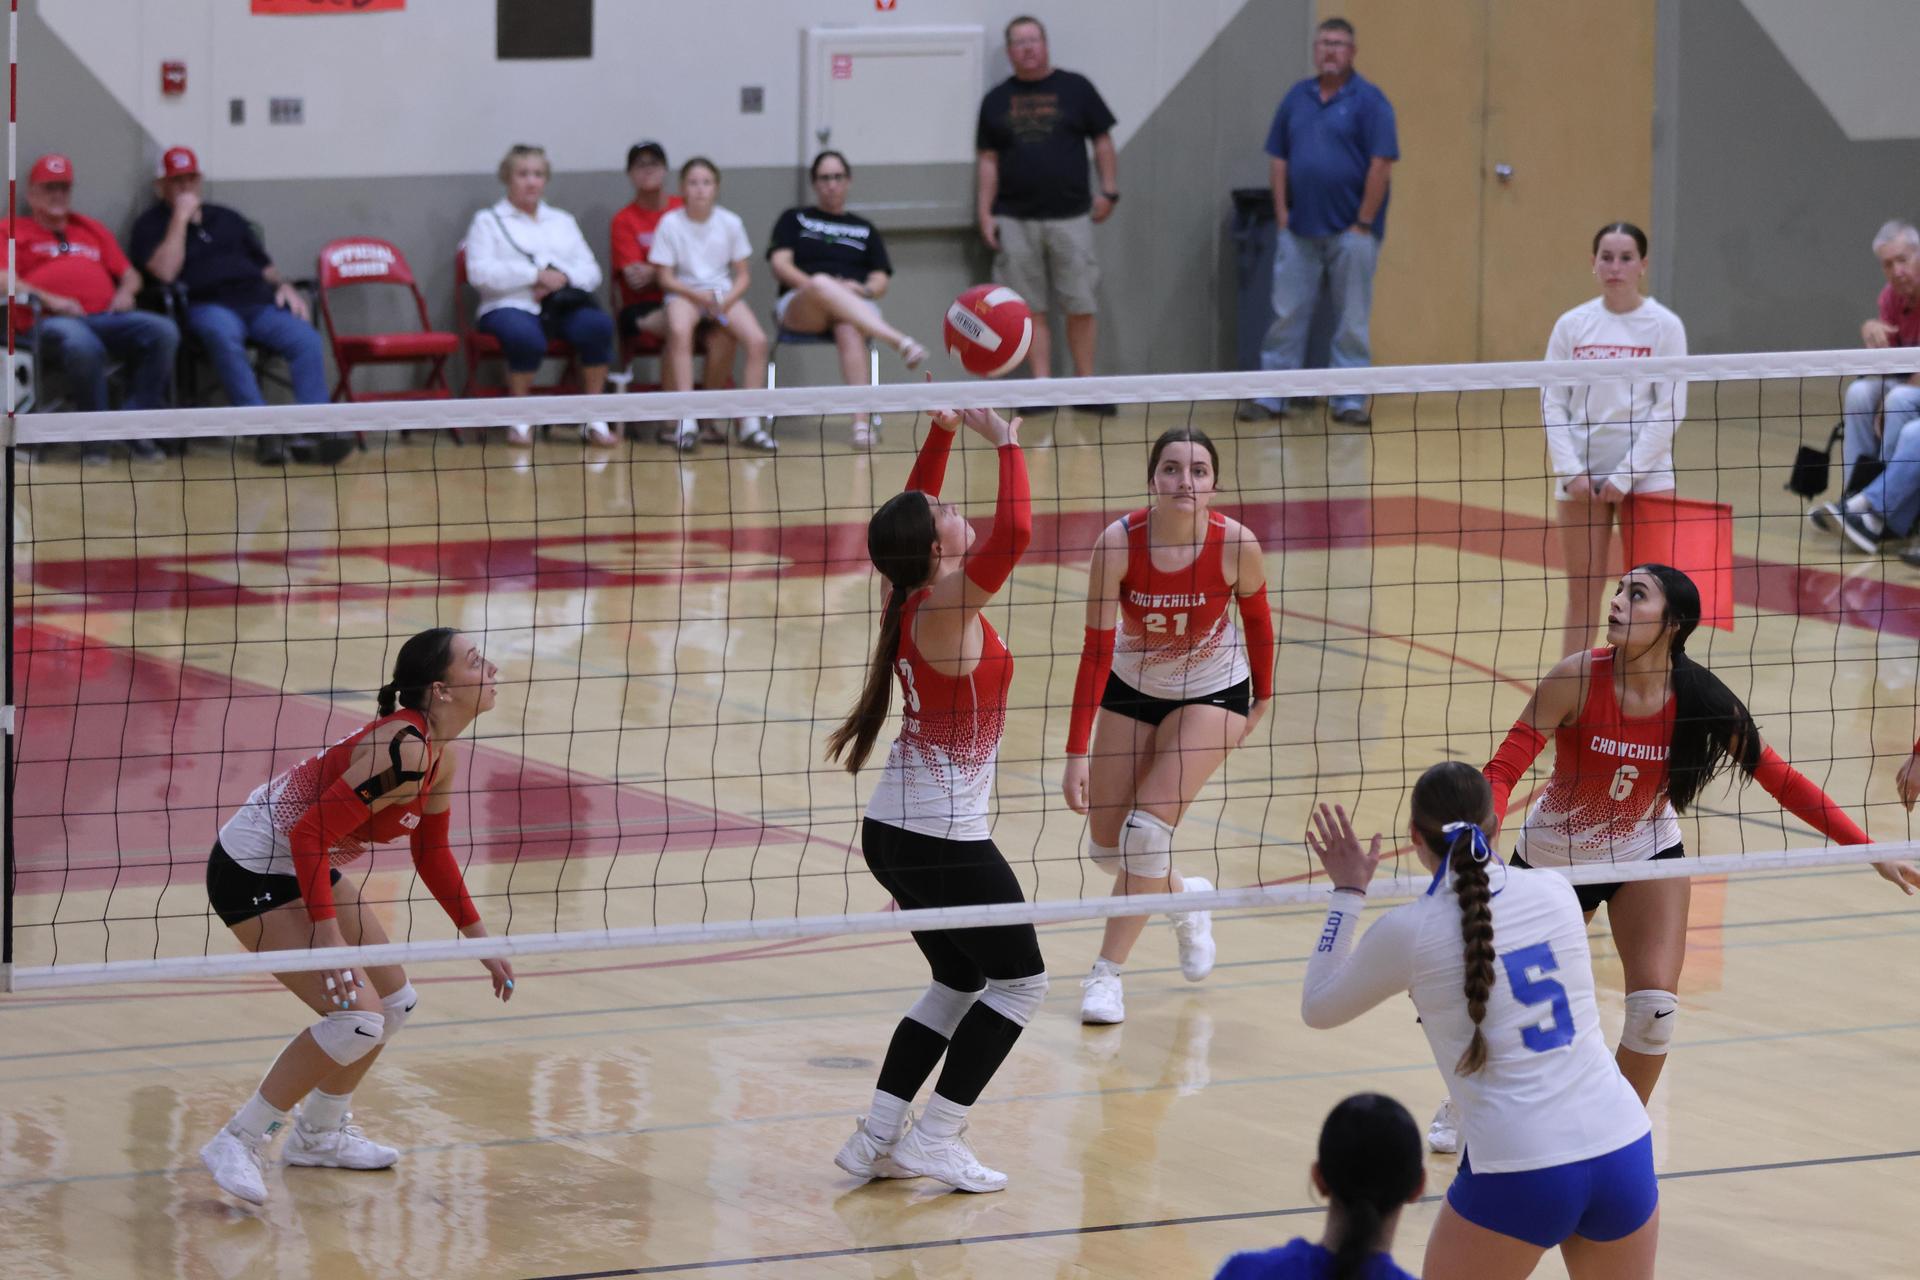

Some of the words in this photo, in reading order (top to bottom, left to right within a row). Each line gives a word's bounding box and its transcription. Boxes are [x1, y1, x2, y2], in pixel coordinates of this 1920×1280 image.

[1130, 590, 1206, 608] CHOWCHILLA
[1142, 613, 1188, 635] 21
[1608, 765, 1640, 801] 6
[1500, 941, 1576, 1053] 5
